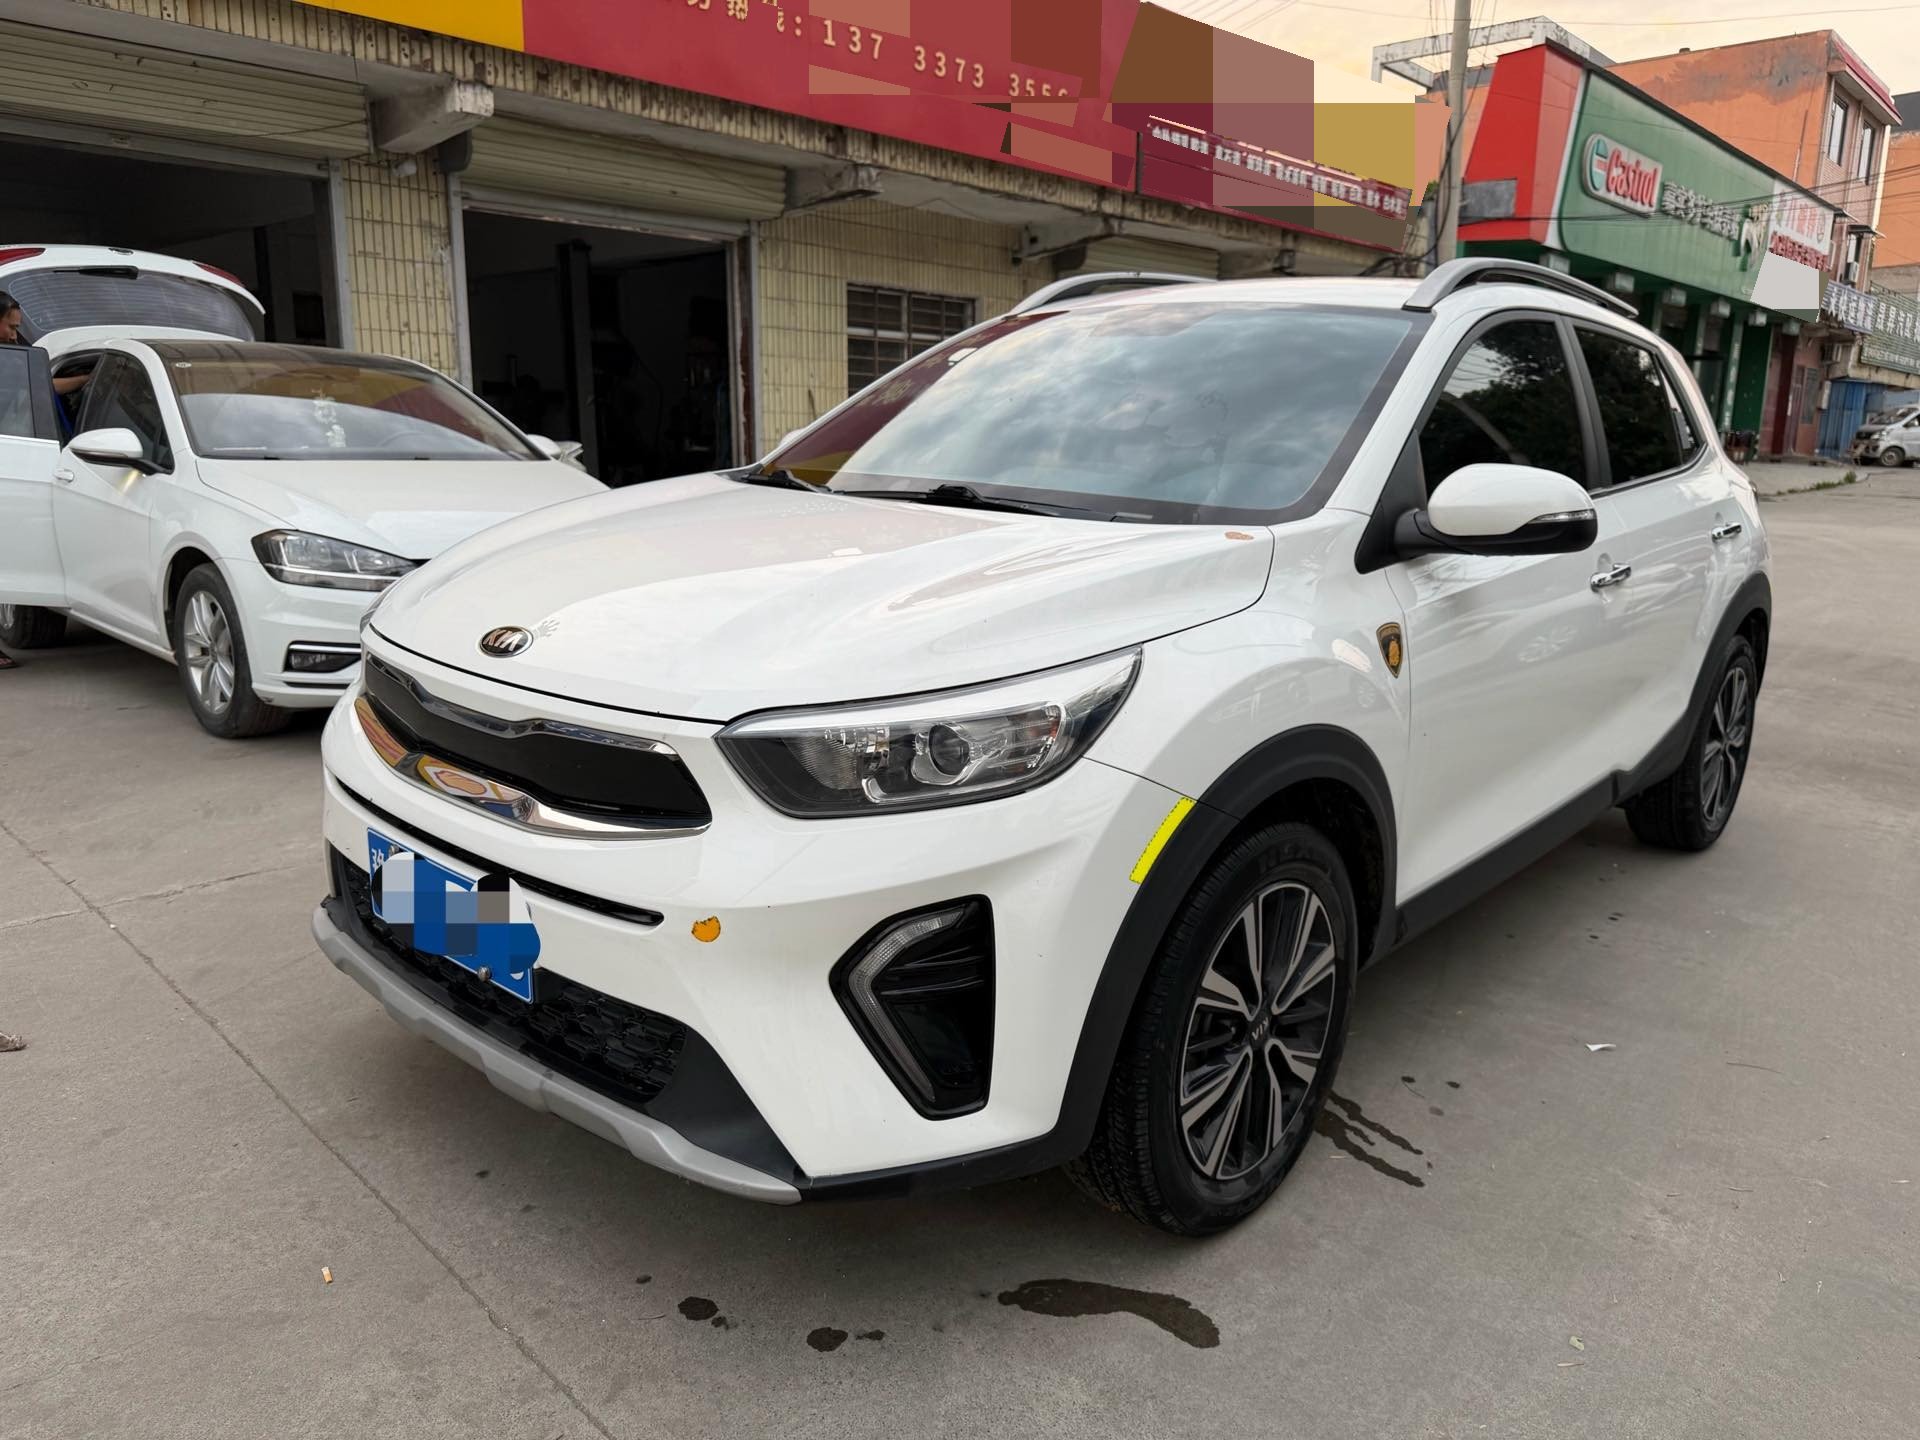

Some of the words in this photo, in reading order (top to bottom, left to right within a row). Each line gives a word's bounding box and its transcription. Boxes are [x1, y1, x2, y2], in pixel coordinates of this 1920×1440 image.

[823, 19, 883, 59] 137
[914, 45, 984, 88] 3373
[1606, 148, 1657, 208] Castrol
[482, 629, 524, 652] KIA
